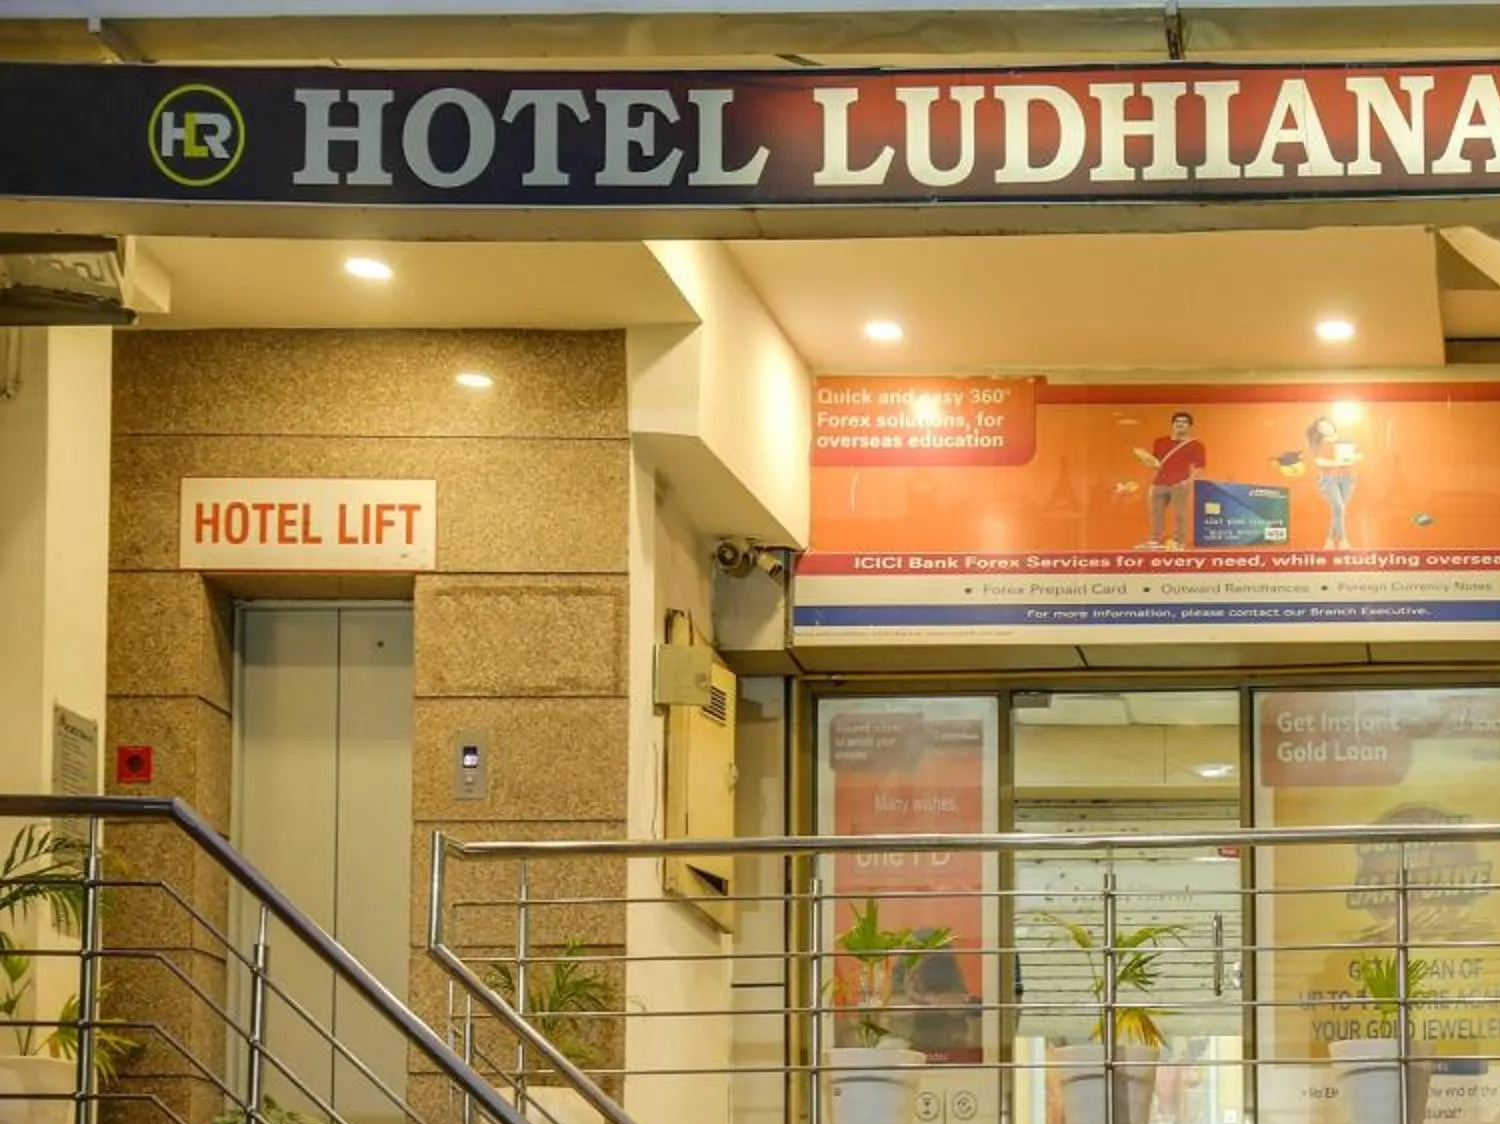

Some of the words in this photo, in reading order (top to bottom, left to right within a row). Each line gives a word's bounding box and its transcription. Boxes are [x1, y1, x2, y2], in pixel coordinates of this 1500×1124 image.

[291, 87, 771, 189] HOTEL
[817, 388, 872, 406] Quick
[816, 411, 871, 428] Forex
[977, 410, 1005, 427] for
[816, 434, 903, 449] overseas
[908, 429, 1005, 448] education
[193, 502, 323, 546] HOTEL
[337, 502, 422, 546] LIFT
[854, 556, 903, 570] ICICI
[908, 556, 959, 570] Bank
[965, 556, 1021, 569] Forex
[1026, 555, 1111, 569] Services
[1116, 555, 1144, 568] for
[1151, 556, 1206, 570] every
[1211, 554, 1267, 569] need,
[1272, 553, 1328, 567] while
[1332, 553, 1420, 569] studying
[983, 583, 1025, 595] Forex
[1030, 583, 1087, 597] Prepaid
[1091, 583, 1128, 595] Card
[1160, 582, 1221, 594] Outward
[1027, 609, 1051, 619] For
[1054, 610, 1088, 619] more
[1092, 608, 1176, 619] information,
[1181, 607, 1224, 619] please
[1228, 607, 1281, 617] contact
[1284, 608, 1306, 617] our
[1311, 605, 1357, 617] Branch
[1276, 712, 1316, 733] Get
[1320, 711, 1400, 733] Instant
[1276, 742, 1327, 763] Gold
[1333, 742, 1388, 763] Loan
[1459, 957, 1485, 979] OF
[1311, 1020, 1361, 1041] YOUR
